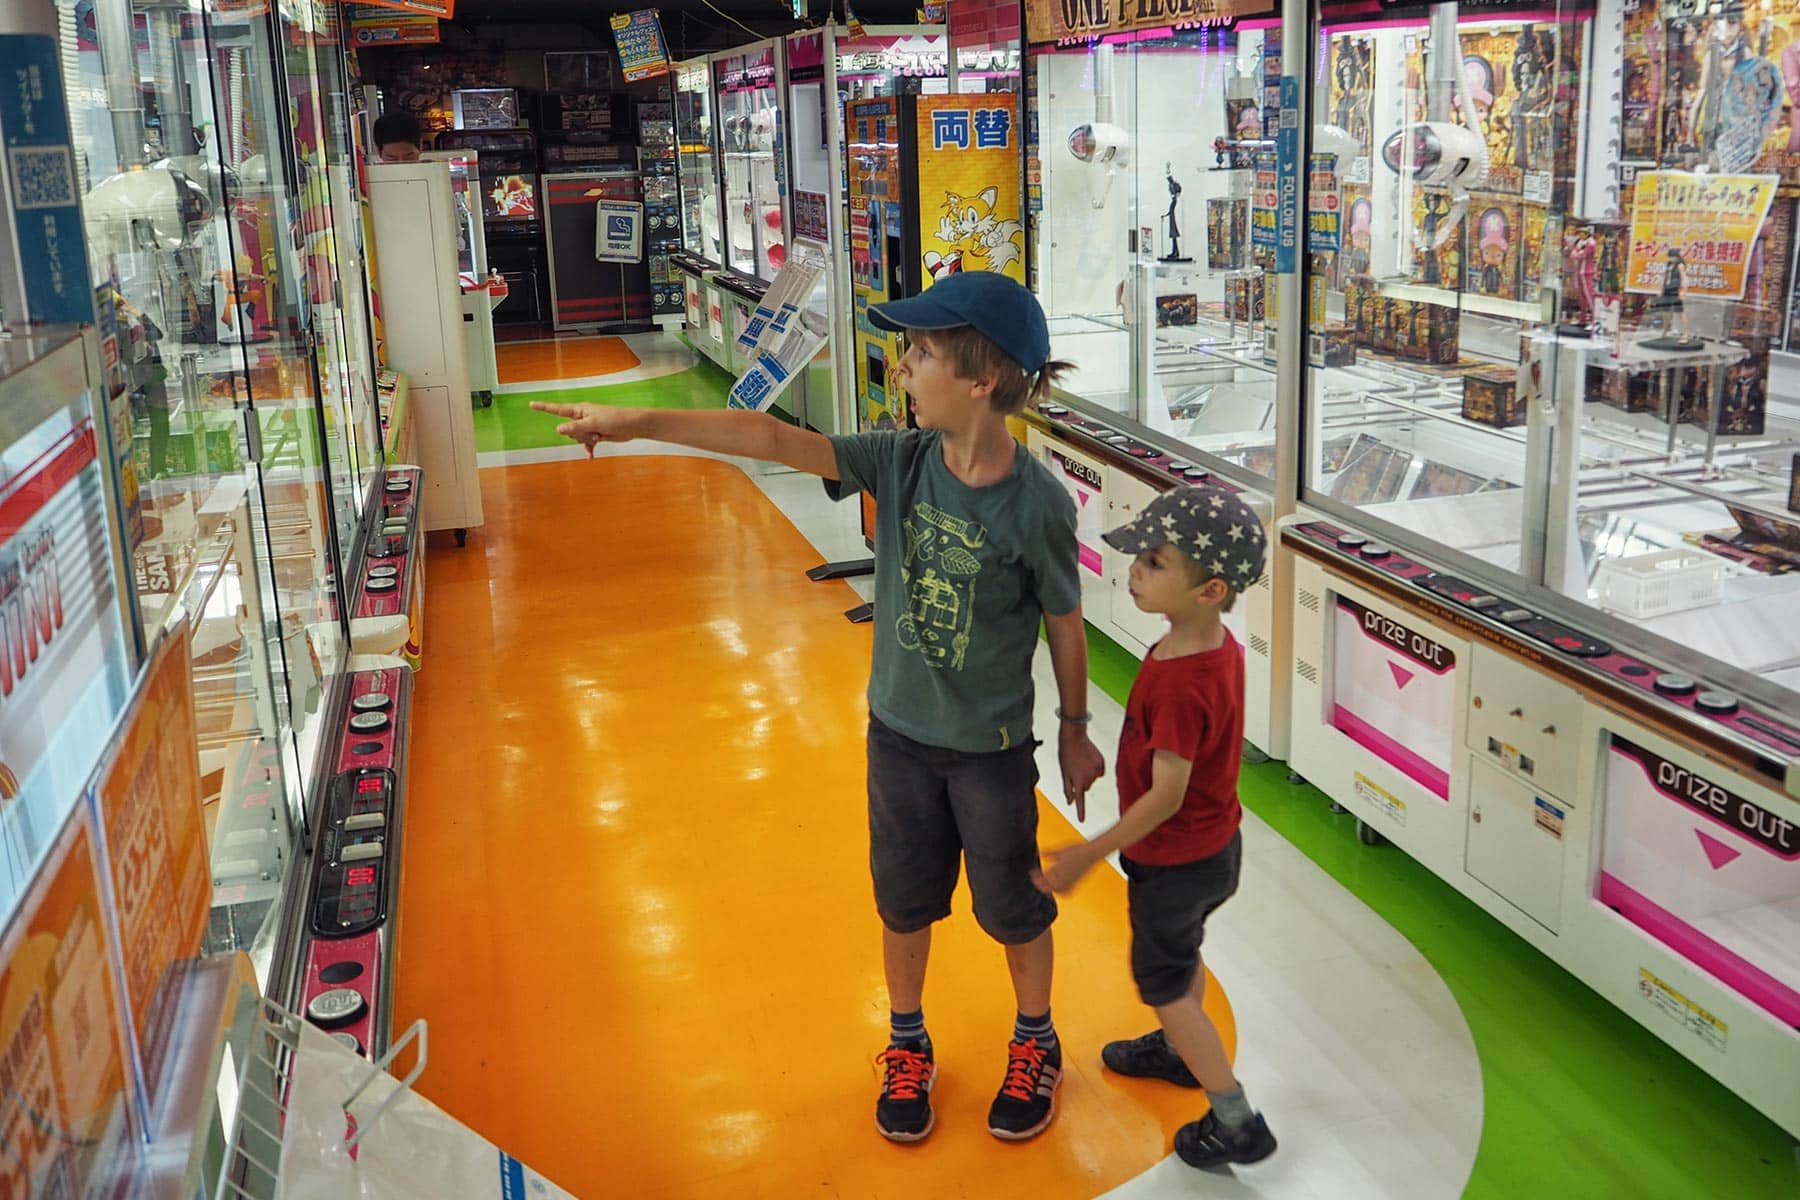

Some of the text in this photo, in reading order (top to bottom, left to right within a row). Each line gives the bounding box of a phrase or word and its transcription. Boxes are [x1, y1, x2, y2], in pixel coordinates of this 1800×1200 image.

[932, 109, 1011, 149] 両替
[1283, 175, 1295, 247] FOLLOW US
[1064, 457, 1085, 478] prize
[1364, 611, 1443, 666] prize out
[1657, 761, 1794, 849] prize out
